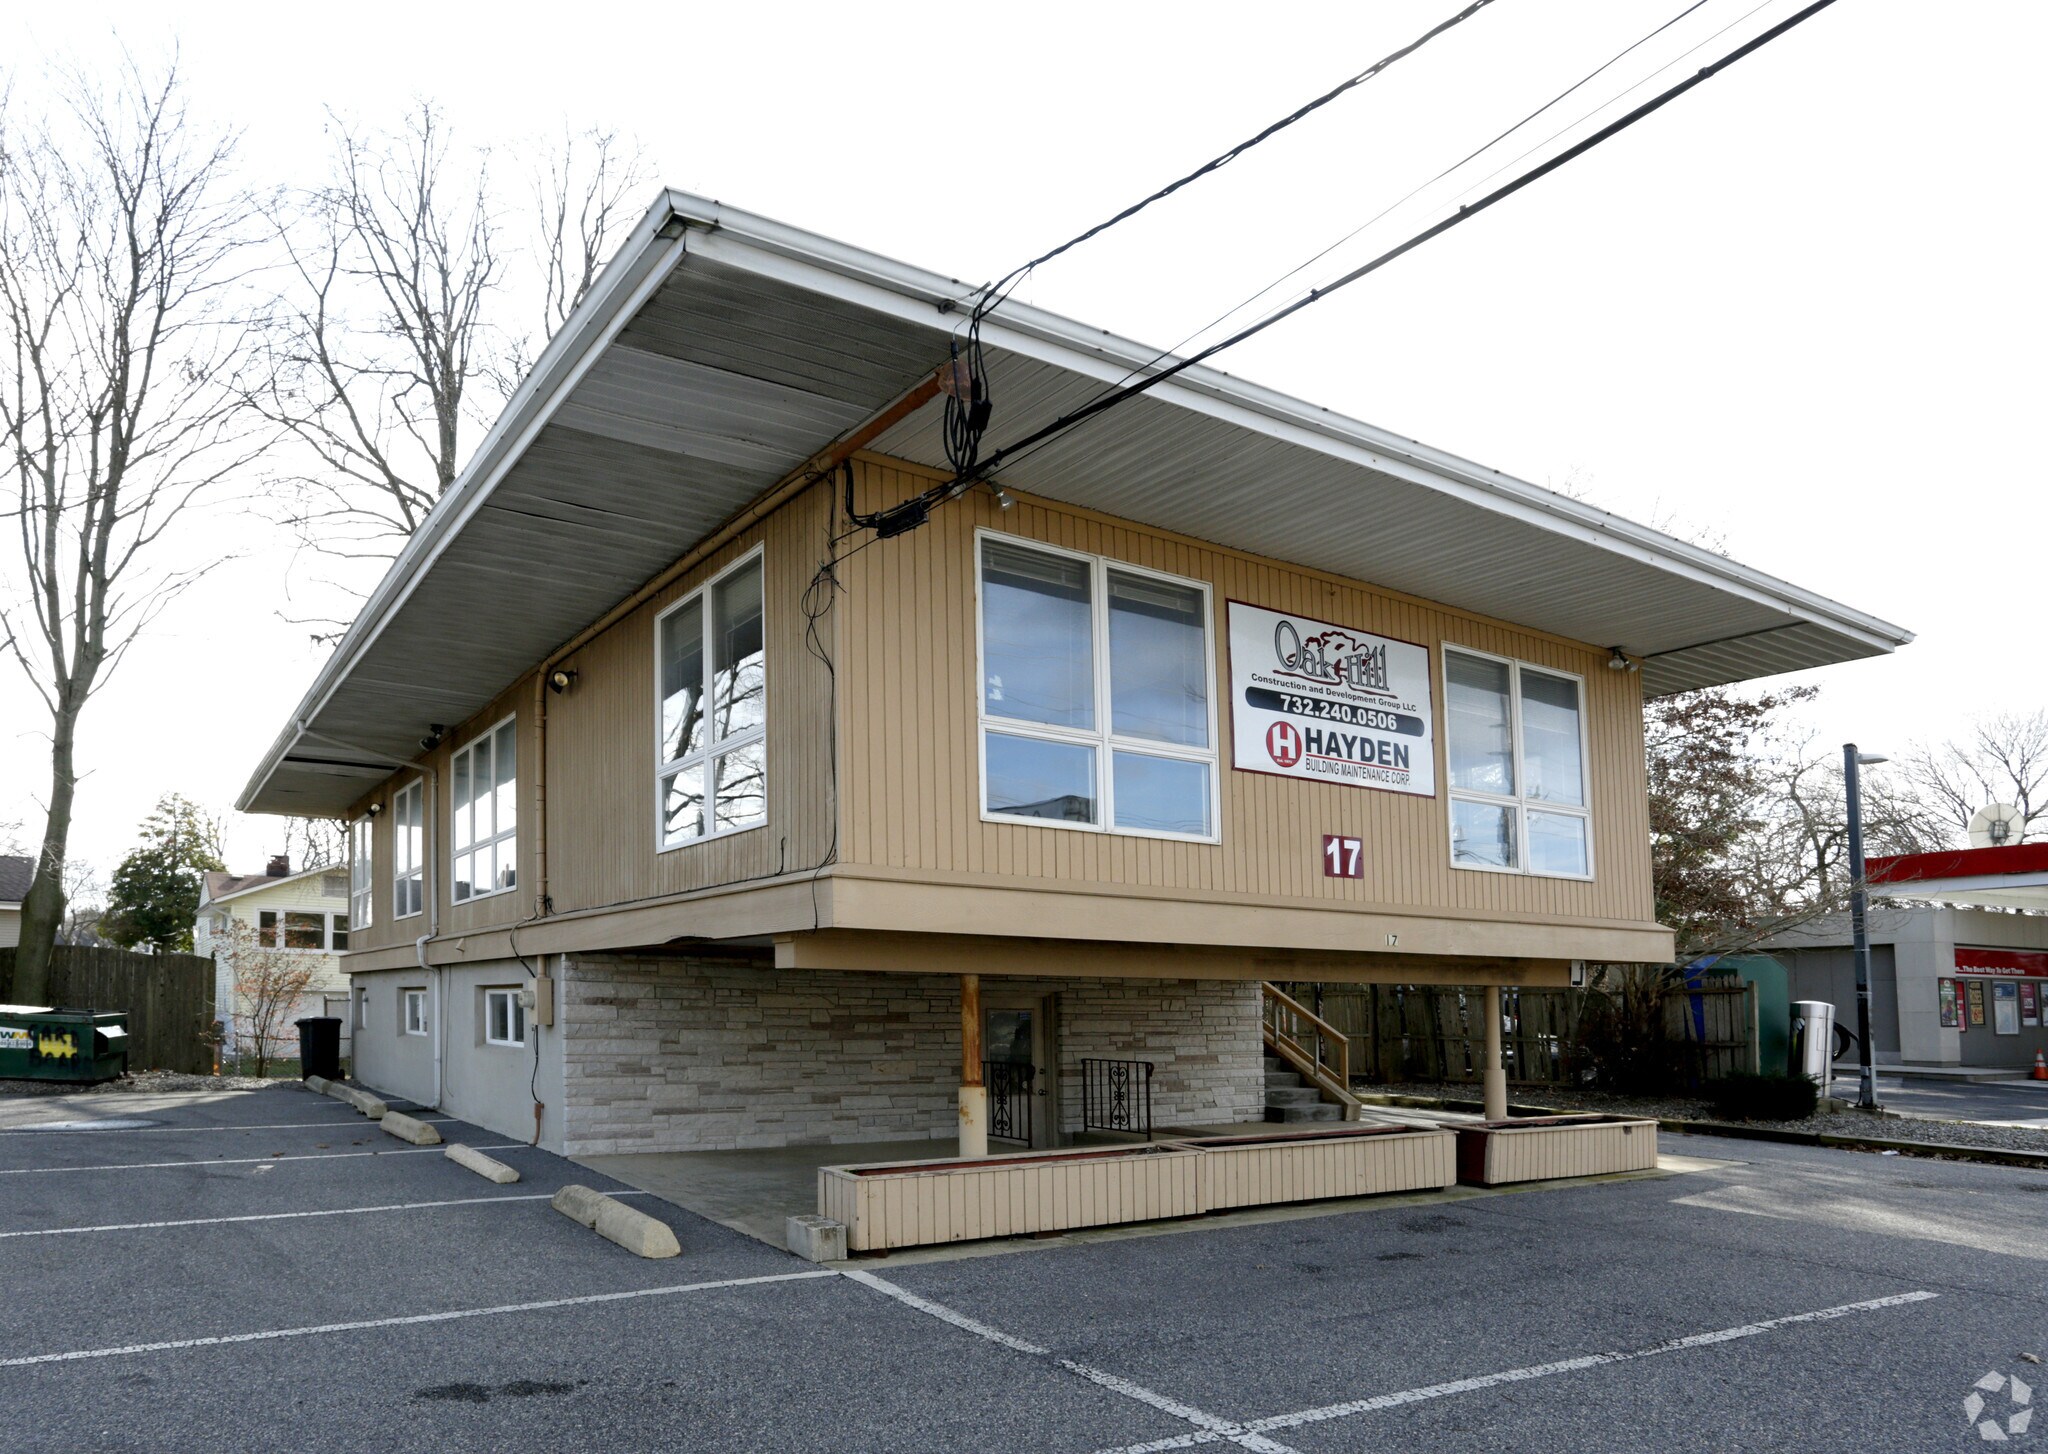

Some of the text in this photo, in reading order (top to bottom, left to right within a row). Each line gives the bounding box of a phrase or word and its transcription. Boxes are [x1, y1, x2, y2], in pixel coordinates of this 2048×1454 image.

[1274, 620, 1390, 691] Oak Hill
[1251, 673, 1417, 712] Construction and Development Group LLC
[1280, 694, 1398, 731] 732.240.0506
[1272, 723, 1297, 760] H
[1305, 727, 1410, 769] HAYDEN
[1305, 759, 1411, 786] BUILDING MAINTENANCE CORP.
[1326, 837, 1361, 876] 17
[1386, 934, 1398, 947] 17
[1985, 966, 1996, 975] Way
